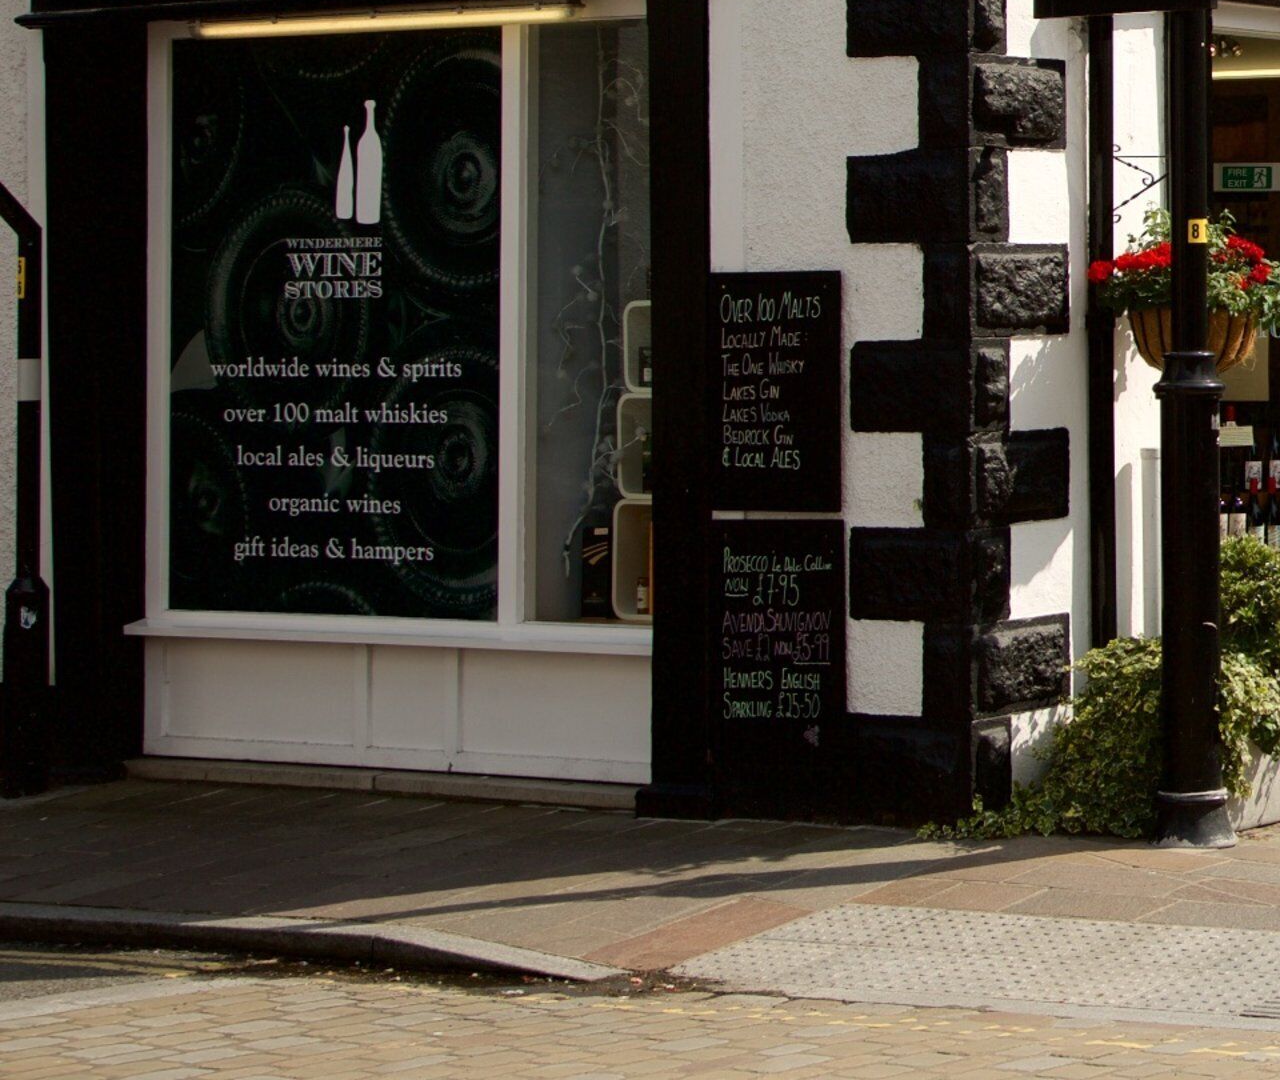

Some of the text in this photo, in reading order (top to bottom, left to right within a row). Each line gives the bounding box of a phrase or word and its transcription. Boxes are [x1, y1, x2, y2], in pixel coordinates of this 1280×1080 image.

[1227, 168, 1247, 177] FIRE
[1227, 179, 1247, 188] EXIT
[1192, 223, 1200, 239] 8
[286, 237, 382, 249] WINDERMERE
[286, 252, 382, 277] WINE
[284, 280, 383, 300] STORES
[720, 291, 821, 323] OVER 100 MALTS
[721, 327, 766, 349] LOCALLY
[210, 356, 462, 382] worldwide wines & spirits
[721, 351, 804, 376] THE ONE WHISKY
[723, 378, 780, 400] LAKES GIN
[224, 402, 448, 424] over 100 malt whiskies
[722, 403, 790, 422] LAKES VODKA
[723, 424, 794, 446] BEDROCK GIN
[237, 445, 435, 472] local ales & liqueurs
[735, 447, 766, 469] LOCAL
[770, 447, 800, 470] ALES
[269, 492, 401, 517] organic wines
[234, 536, 434, 565] gift ideas & hampers
[723, 546, 768, 574] PROSECCO
[767, 609, 831, 633] SAUVIGNON
[722, 637, 753, 660] SAVE
[723, 667, 820, 690] HENNERS ENGLISH
[723, 692, 772, 719] SPARKLING
